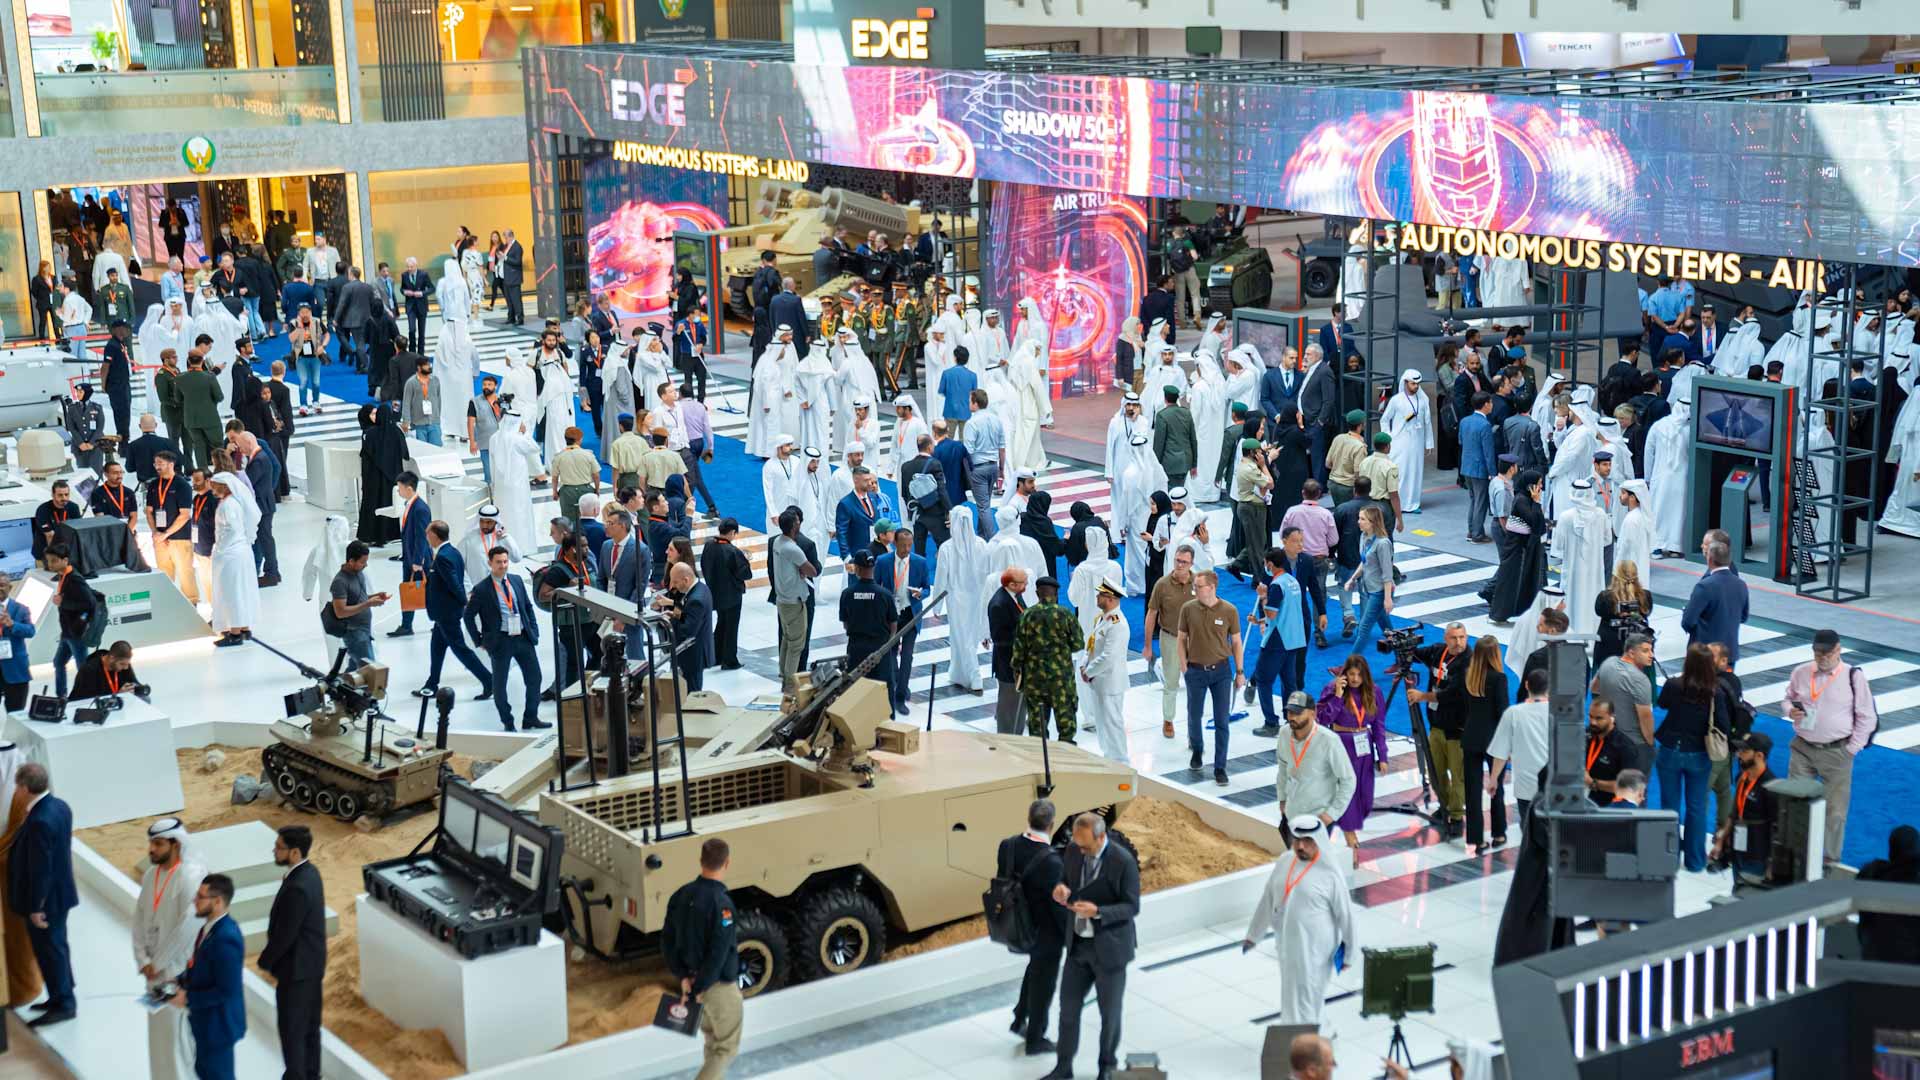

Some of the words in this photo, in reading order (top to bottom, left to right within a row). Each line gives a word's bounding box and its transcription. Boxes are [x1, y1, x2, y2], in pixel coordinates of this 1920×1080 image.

[851, 18, 929, 60] EDGE
[610, 78, 687, 127] EDGE
[1002, 109, 1082, 139] SHADOW
[612, 140, 701, 171] AUTONOMOUS
[701, 151, 759, 178] SYSTEMS
[767, 159, 809, 183] LAND
[1053, 194, 1078, 211] AIR
[1400, 222, 1601, 271] AUTONOMOUS
[1608, 241, 1742, 285] SYSTEMS
[1768, 257, 1828, 293] AIR
[107, 593, 128, 604] ADE
[1680, 1026, 1735, 1069] EBM
